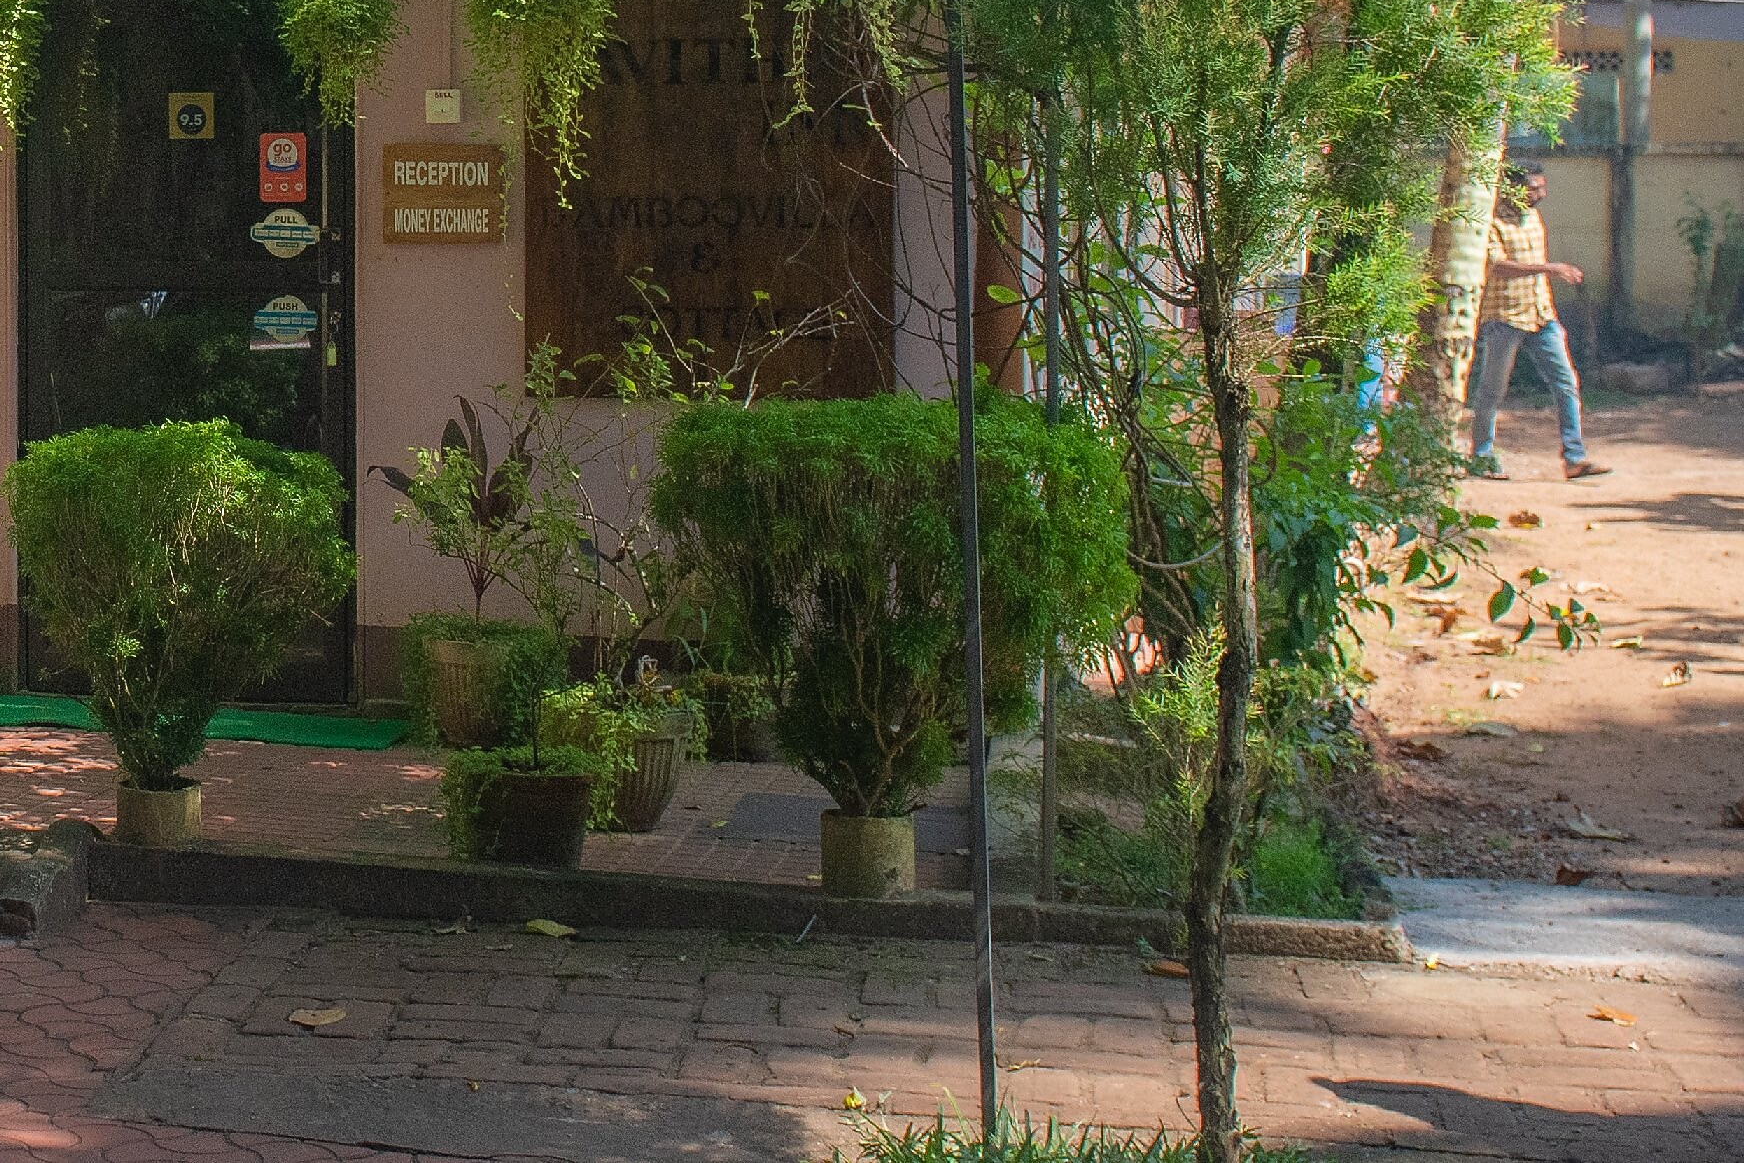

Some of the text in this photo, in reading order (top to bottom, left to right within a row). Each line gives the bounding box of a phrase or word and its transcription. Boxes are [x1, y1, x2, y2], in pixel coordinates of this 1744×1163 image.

[179, 113, 202, 126] 9.5
[273, 143, 292, 156] go
[394, 160, 489, 186] RECEPTION
[274, 215, 298, 224] PULL
[394, 208, 489, 234] MONEY EXCHANGE
[272, 302, 299, 311] PUSH
